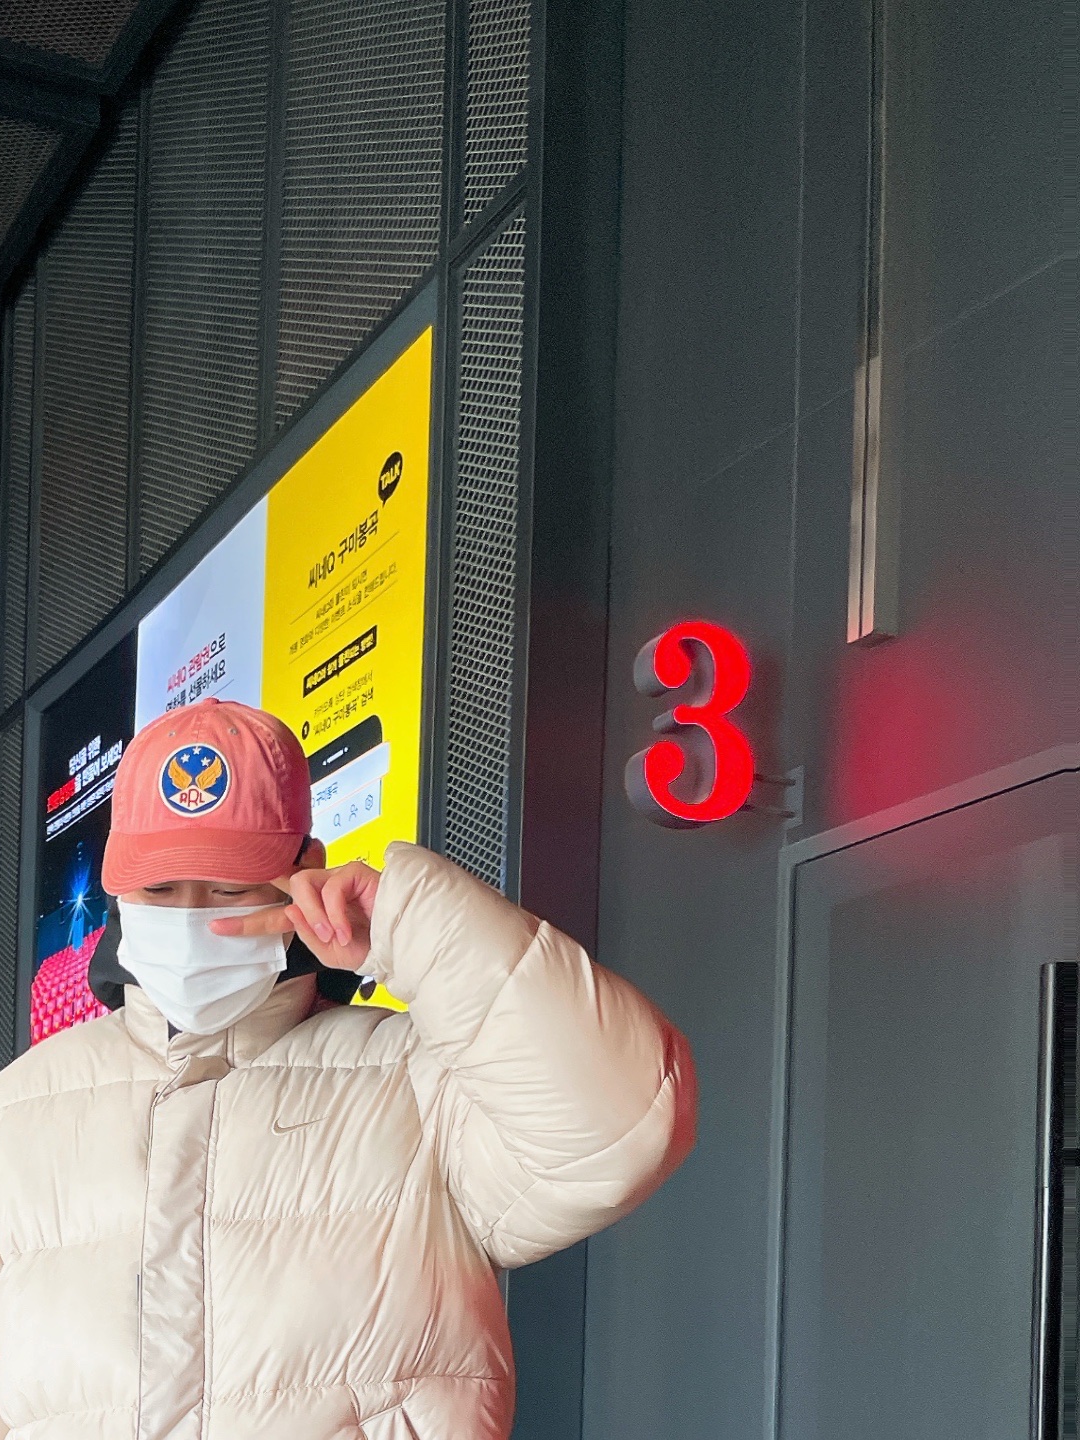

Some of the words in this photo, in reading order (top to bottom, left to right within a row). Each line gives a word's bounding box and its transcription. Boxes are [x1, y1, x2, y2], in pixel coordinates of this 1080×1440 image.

[380, 460, 400, 490] TALK
[308, 551, 335, 589] 씨네Q
[338, 509, 379, 564] 구미봉곡
[166, 665, 187, 693] 씨네Q
[188, 632, 226, 678] 관람권으로
[188, 659, 226, 703] 선물하세요
[361, 686, 374, 708] 검색
[643, 620, 754, 822] 3
[69, 747, 87, 776] 당신을
[87, 735, 101, 760] 위한
